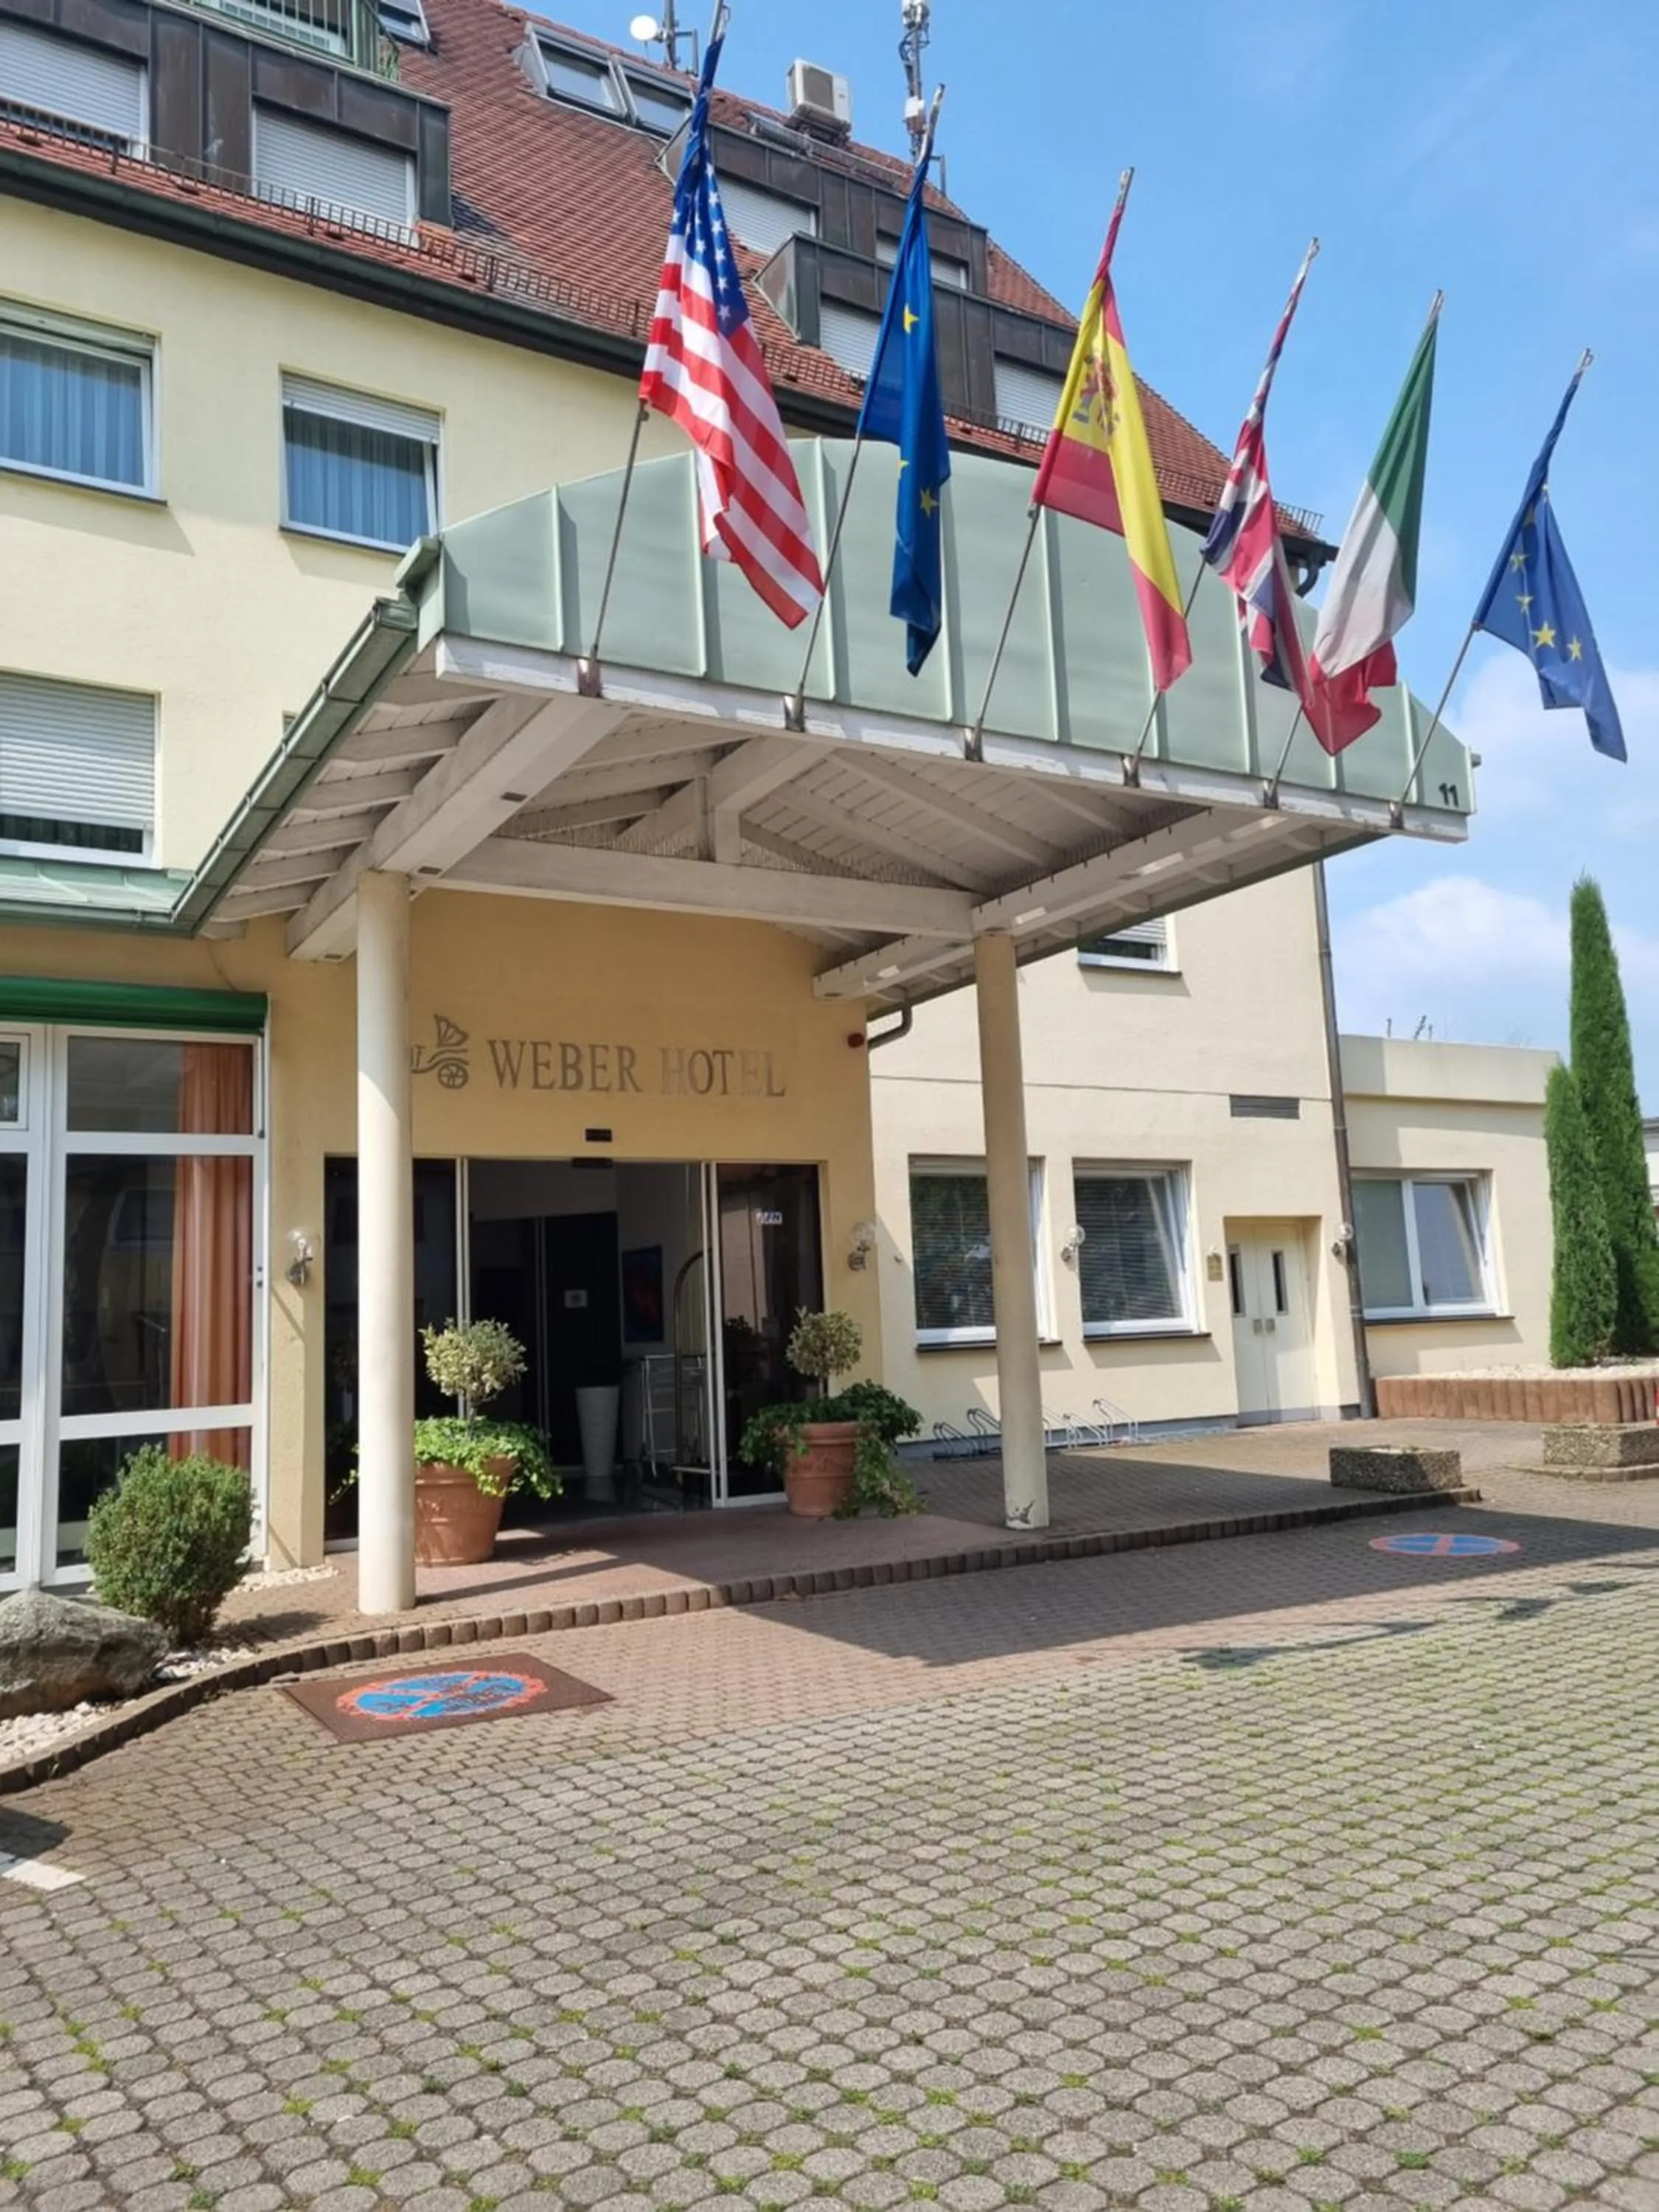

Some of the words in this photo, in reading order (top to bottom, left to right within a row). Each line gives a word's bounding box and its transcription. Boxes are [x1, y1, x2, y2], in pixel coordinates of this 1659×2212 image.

[1439, 782, 1459, 808] 11
[486, 1038, 644, 1093] WEBER
[660, 1046, 786, 1097] HOTEL
